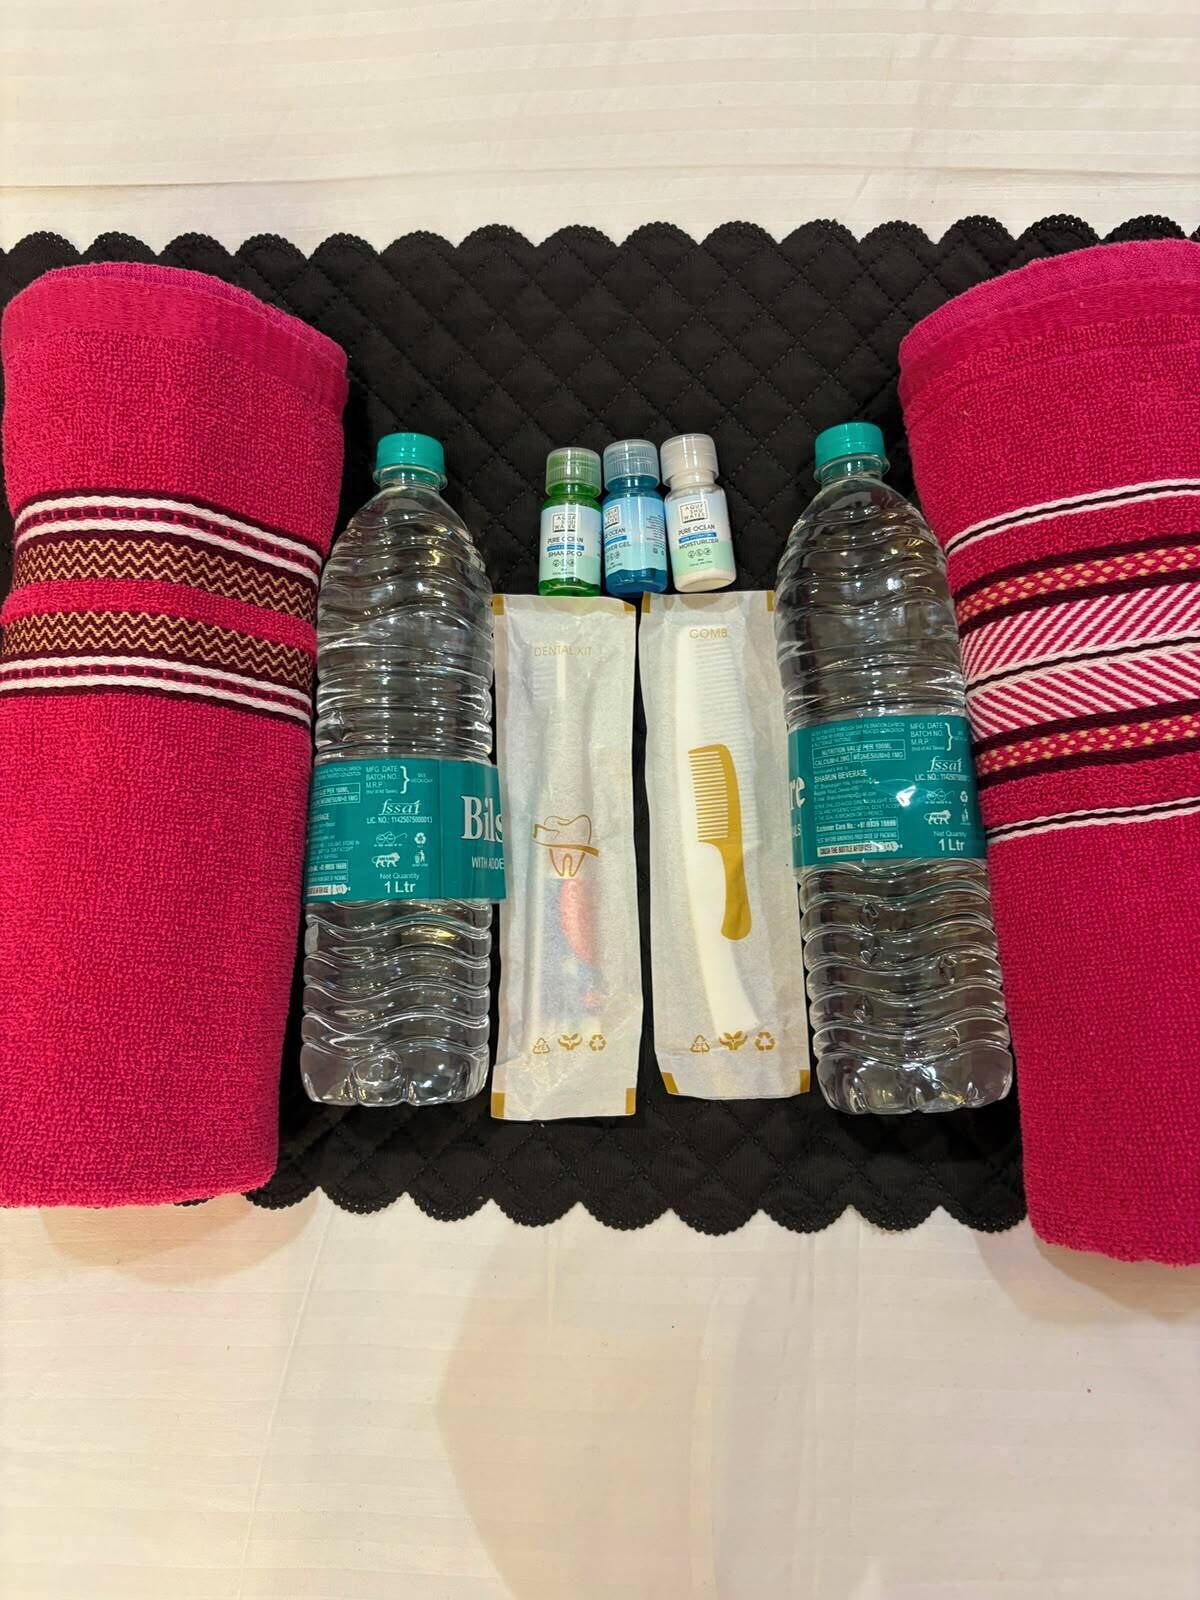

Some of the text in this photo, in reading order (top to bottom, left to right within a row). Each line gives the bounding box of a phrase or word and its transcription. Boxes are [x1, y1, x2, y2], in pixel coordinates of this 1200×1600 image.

[679, 524, 716, 535] PURE OCEAN
[679, 538, 720, 549] MOISTURIZER
[689, 627, 728, 640] COMB
[534, 645, 593, 657] DENTAL KIT
[911, 730, 932, 738] BATCH
[366, 765, 380, 773] MFG.
[381, 765, 398, 773] DATE
[837, 769, 868, 780] BEVERAGE
[366, 773, 386, 781] BATCH
[938, 838, 965, 852] 1 Ltr
[471, 856, 487, 869] WITH
[380, 872, 420, 881] Net Quantity
[384, 881, 417, 894] 1 Ltr
